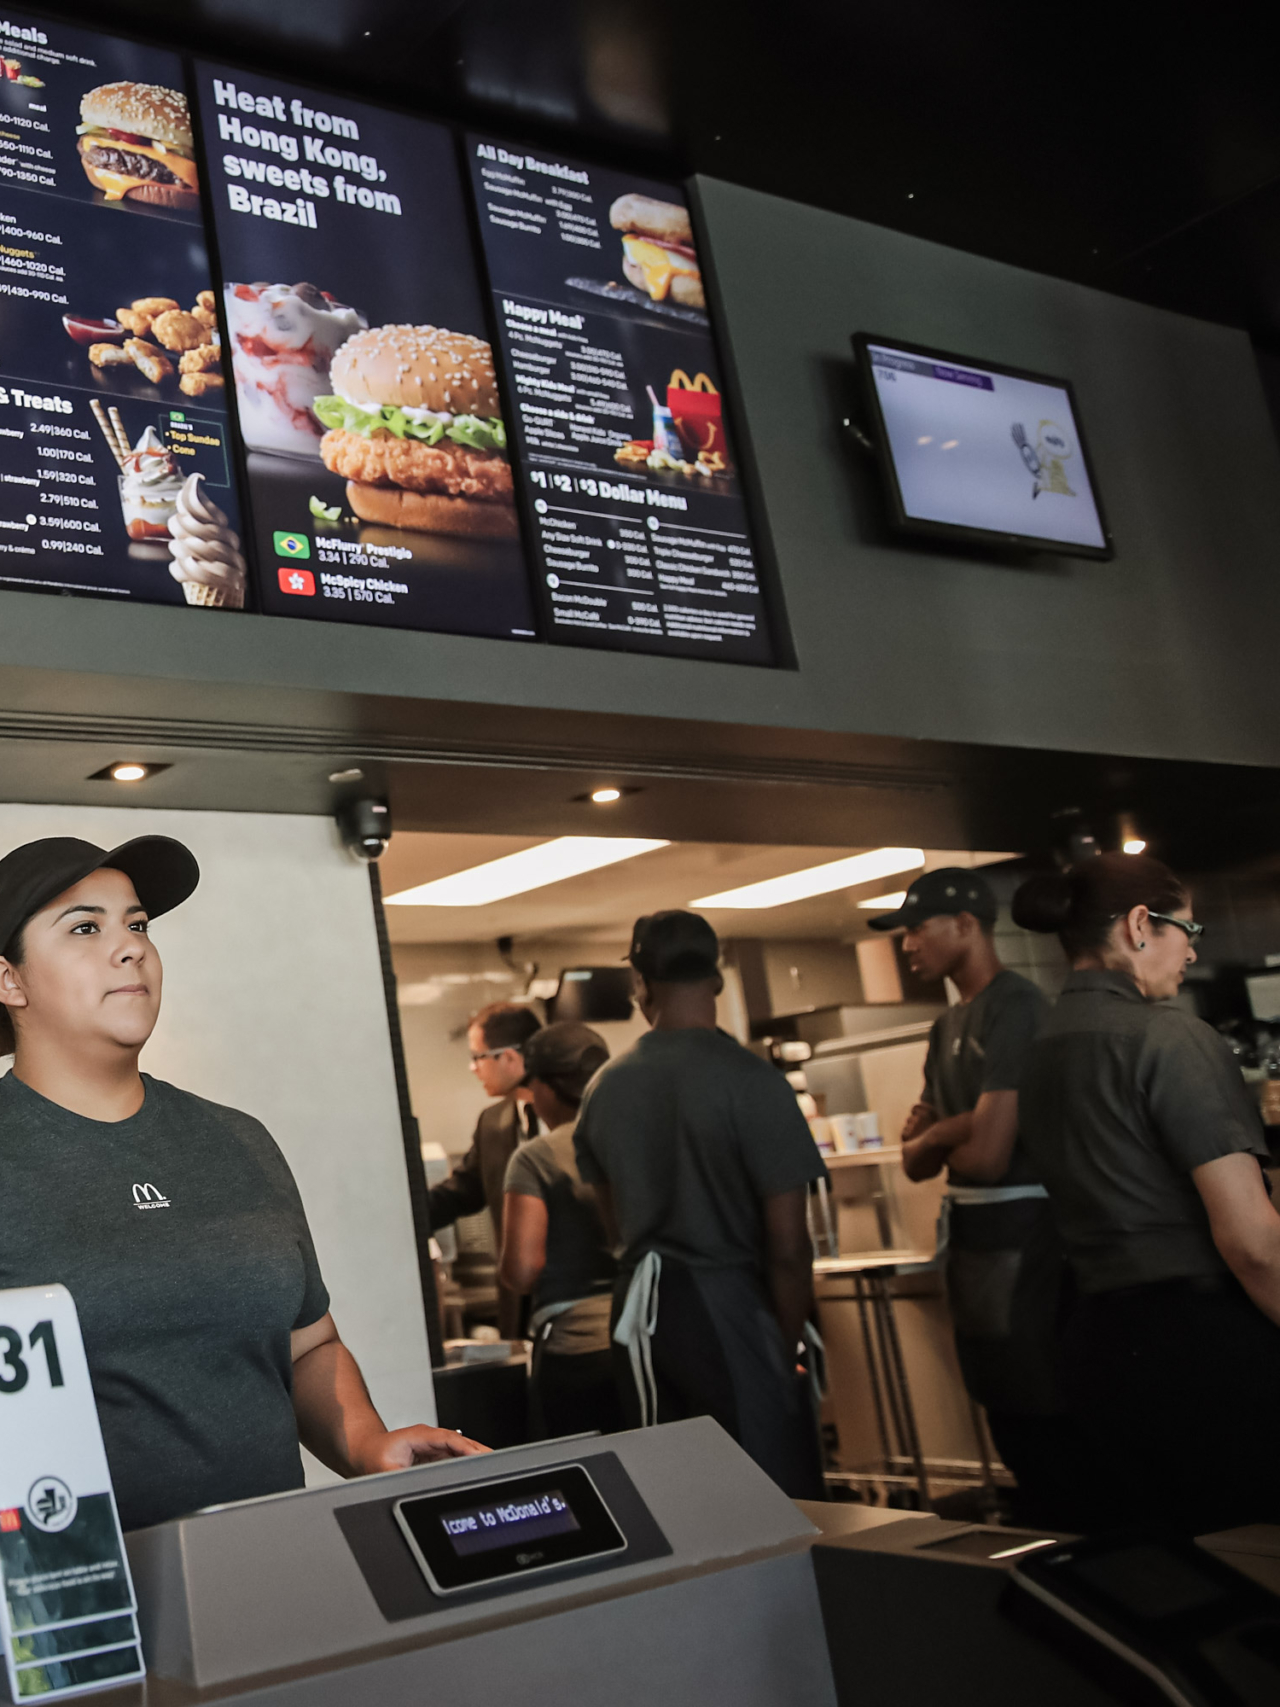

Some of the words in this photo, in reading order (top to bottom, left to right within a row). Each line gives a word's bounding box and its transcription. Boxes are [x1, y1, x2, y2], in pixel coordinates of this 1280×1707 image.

[28, 102, 47, 112] meal
[213, 79, 287, 121] Heat
[291, 100, 359, 140] from
[218, 114, 299, 161] Hong
[303, 135, 387, 182] Kong,
[477, 144, 496, 161] All
[498, 148, 524, 169] Day
[525, 156, 590, 185] Breakfast
[223, 154, 330, 197] sweets
[333, 175, 402, 215] from
[227, 183, 318, 229] Brazil
[45, 234, 63, 245] Cal.
[503, 299, 548, 325] Happy
[11, 389, 73, 414] Treats
[598, 481, 645, 504] Dollar
[646, 488, 688, 511] Menu
[320, 573, 365, 590] McSpicy
[366, 580, 408, 594] Chicken
[480, 1512, 496, 1526] to
